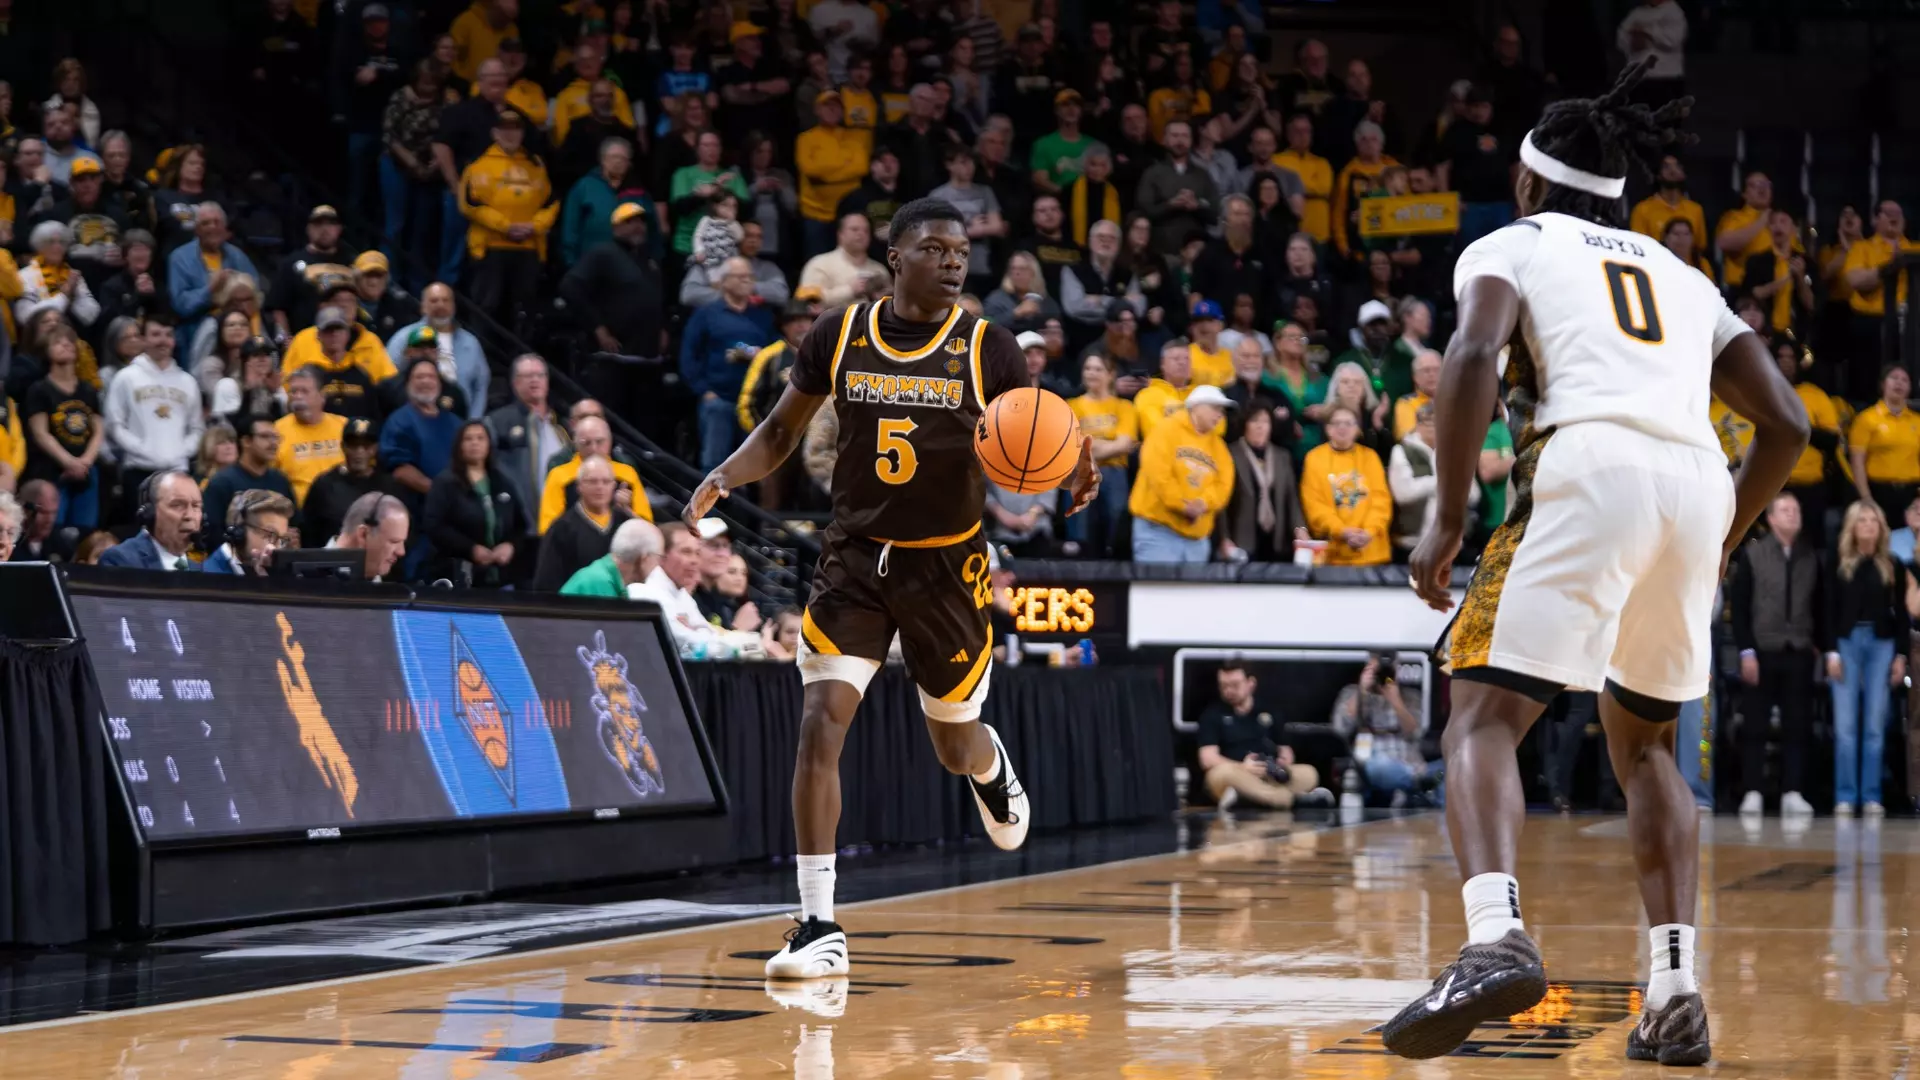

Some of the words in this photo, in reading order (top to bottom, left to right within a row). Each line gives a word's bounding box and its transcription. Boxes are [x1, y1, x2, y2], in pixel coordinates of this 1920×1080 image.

[1580, 230, 1645, 257] BOYD
[1600, 259, 1665, 345] 0
[845, 370, 964, 409] WYOMING
[875, 416, 919, 485] 5
[120, 616, 137, 653] 4
[166, 618, 185, 656] 0
[127, 678, 164, 701] HOME
[171, 679, 215, 701] VISITOR
[165, 755, 180, 784] 0
[214, 756, 227, 783] 1
[183, 800, 196, 826] 4
[228, 798, 241, 824] 4
